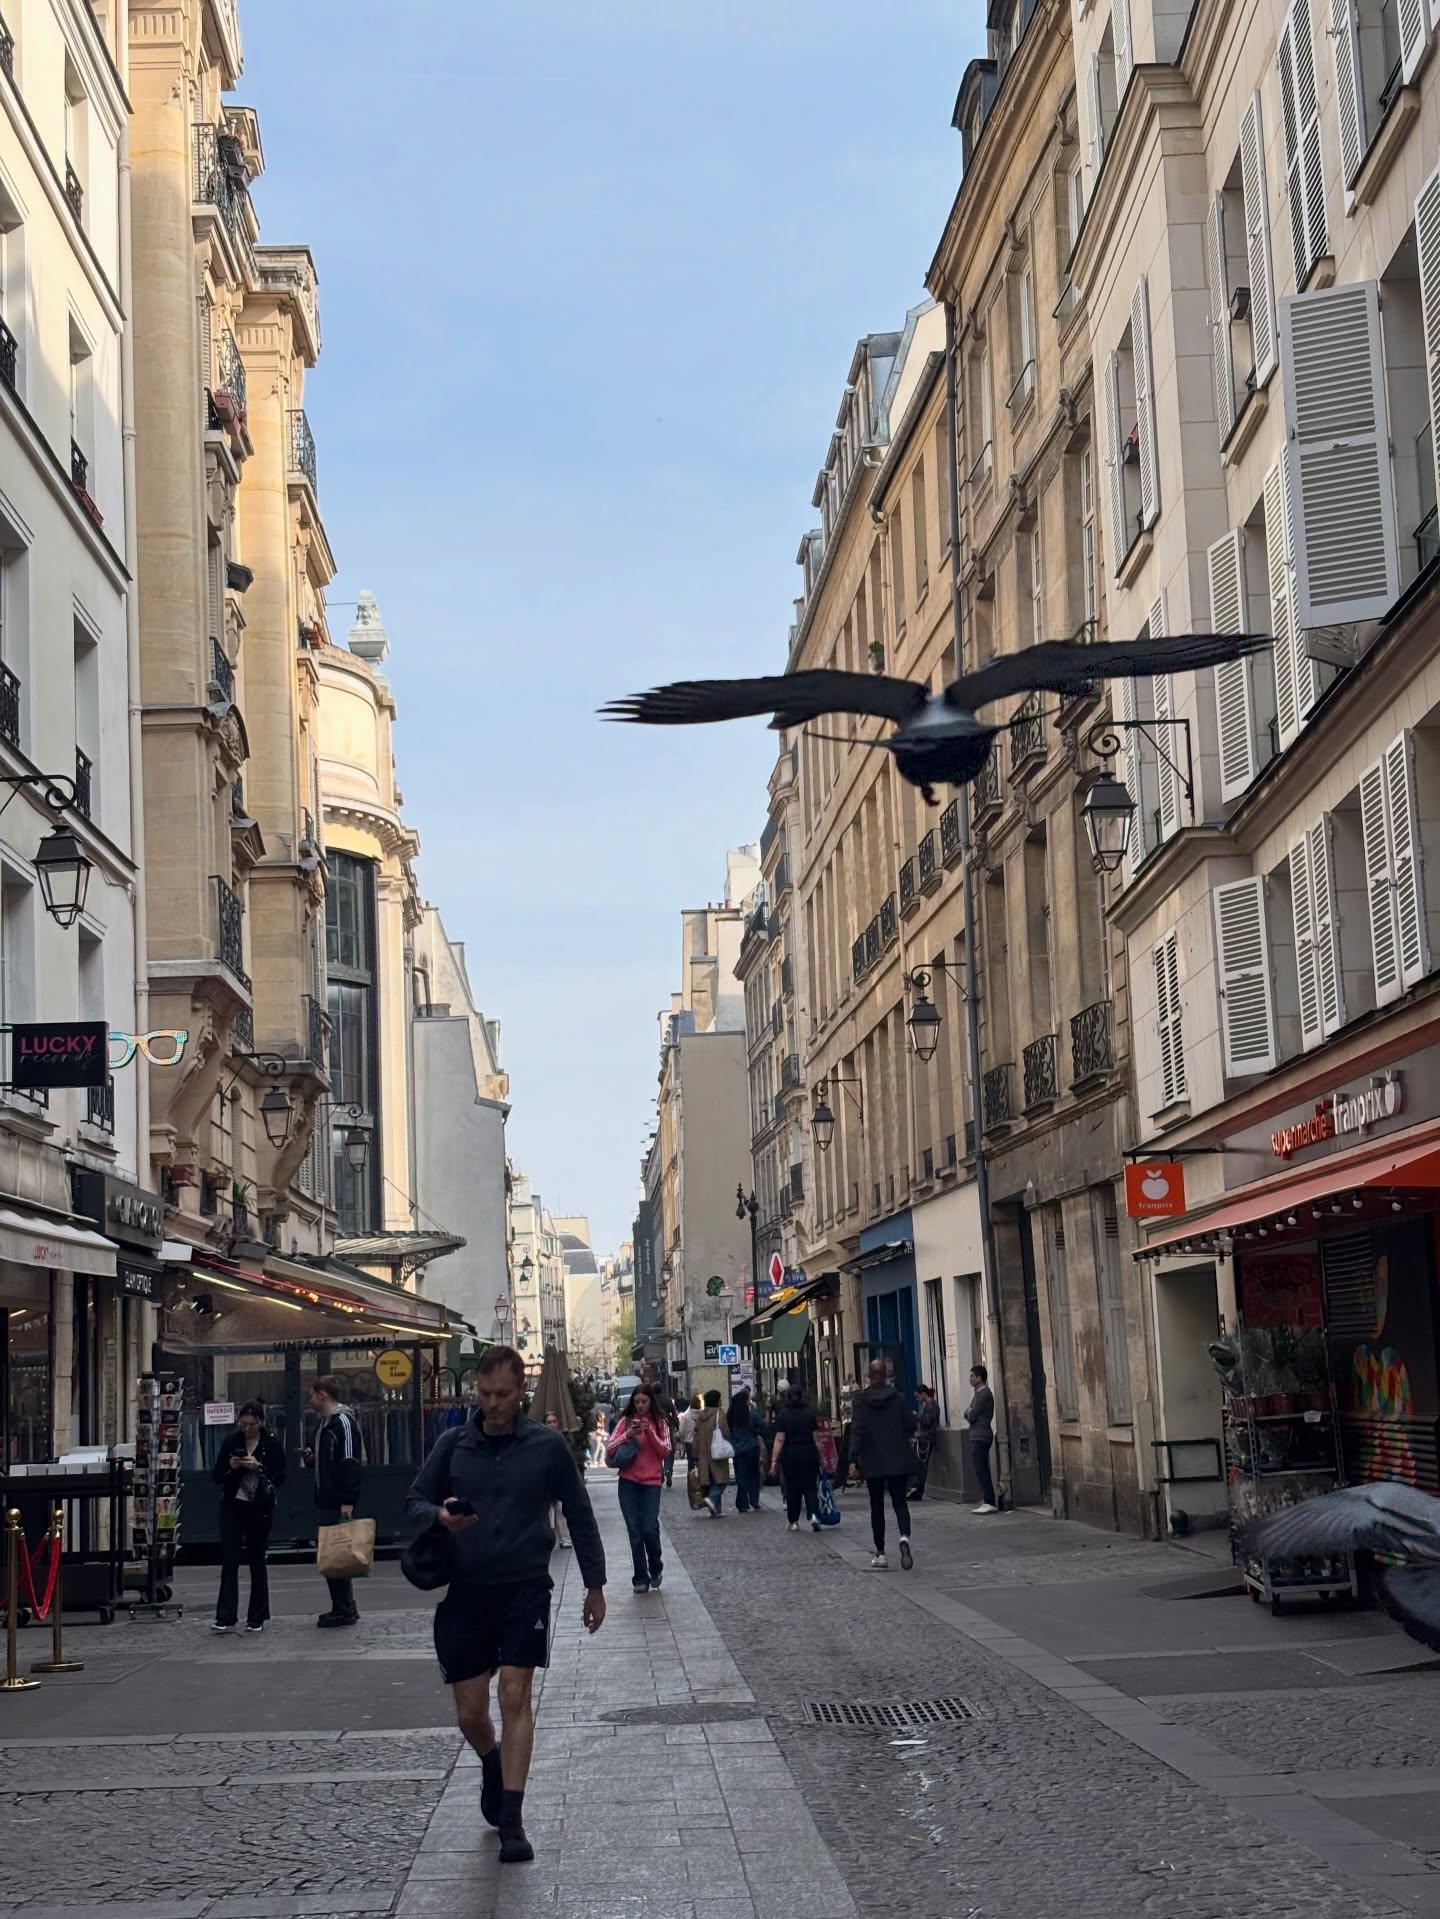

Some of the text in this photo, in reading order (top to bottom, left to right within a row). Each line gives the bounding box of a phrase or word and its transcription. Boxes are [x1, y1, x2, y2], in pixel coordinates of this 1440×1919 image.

[21, 1034, 97, 1054] LUCKY
[1271, 1078, 1383, 1153] supermarché franprix
[272, 1339, 332, 1351] VINTAGE
[206, 1406, 233, 1415] INTERDIT
